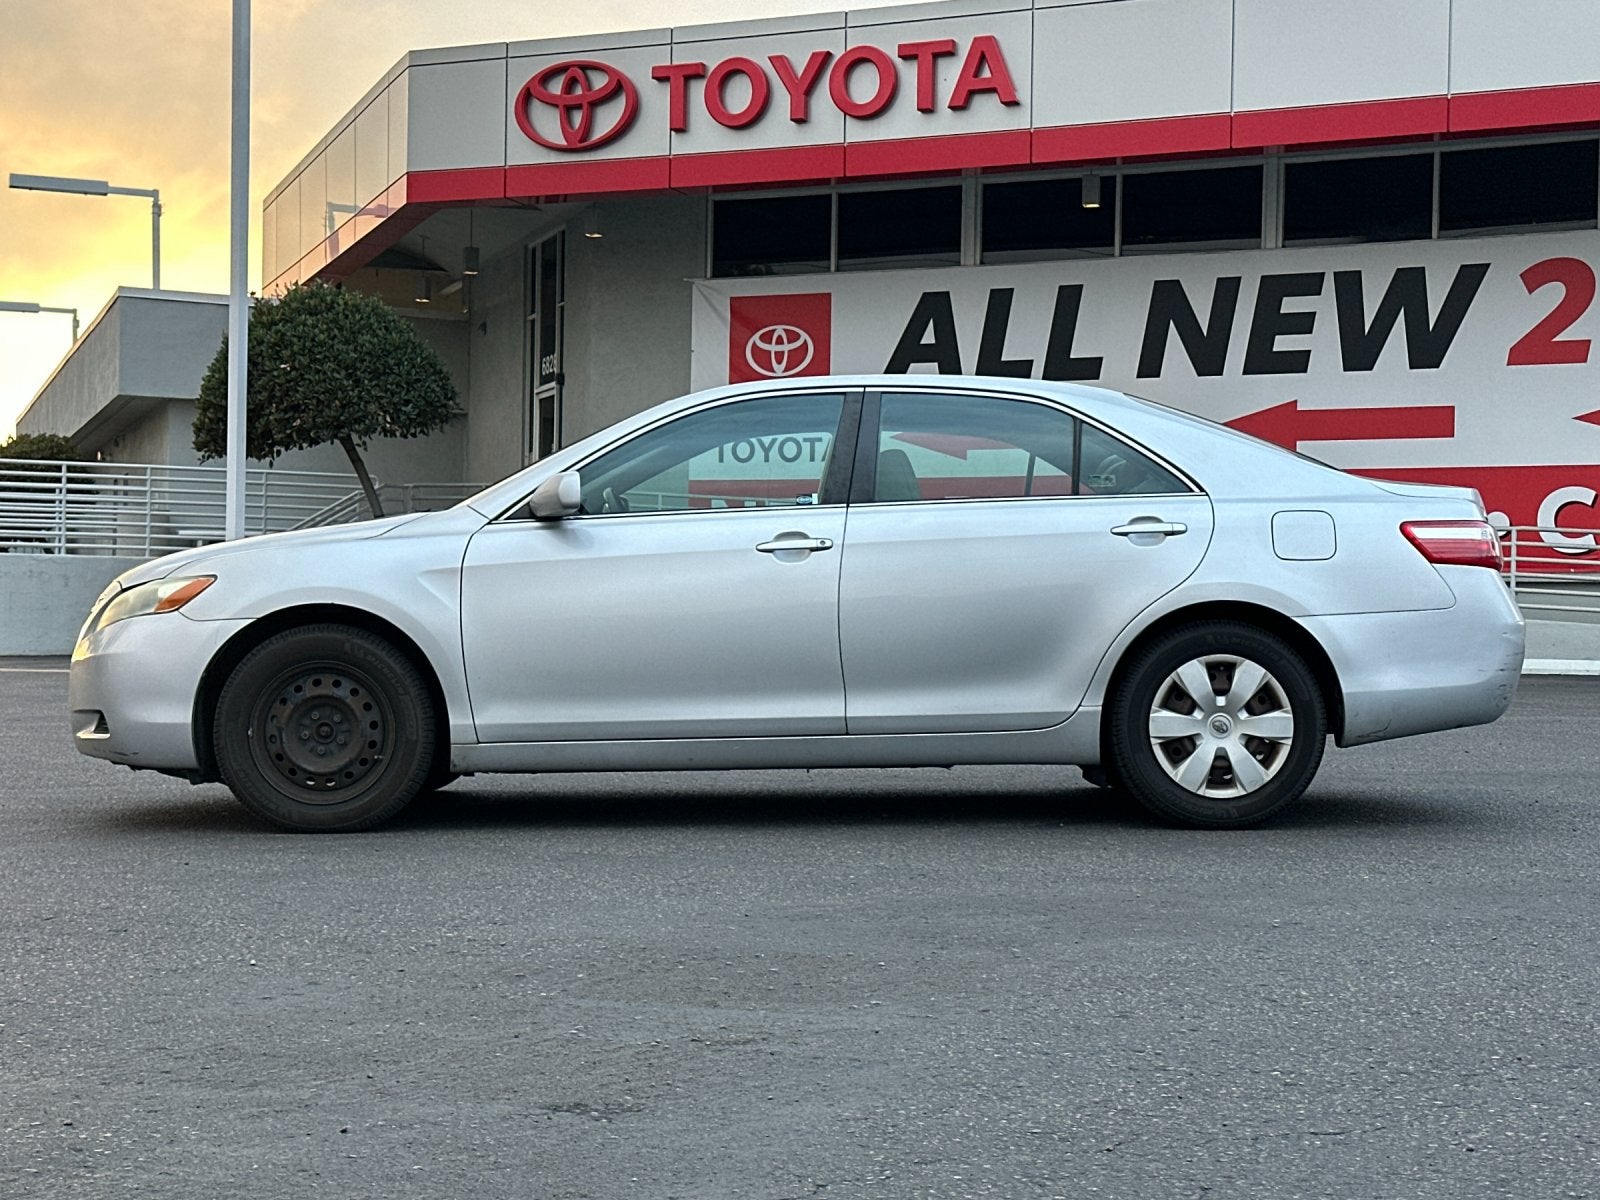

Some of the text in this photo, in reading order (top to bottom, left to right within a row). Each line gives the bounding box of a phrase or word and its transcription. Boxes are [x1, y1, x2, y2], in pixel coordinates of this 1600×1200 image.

[652, 35, 1019, 132] TOYOTA
[883, 257, 1597, 381] ALL NEW 2
